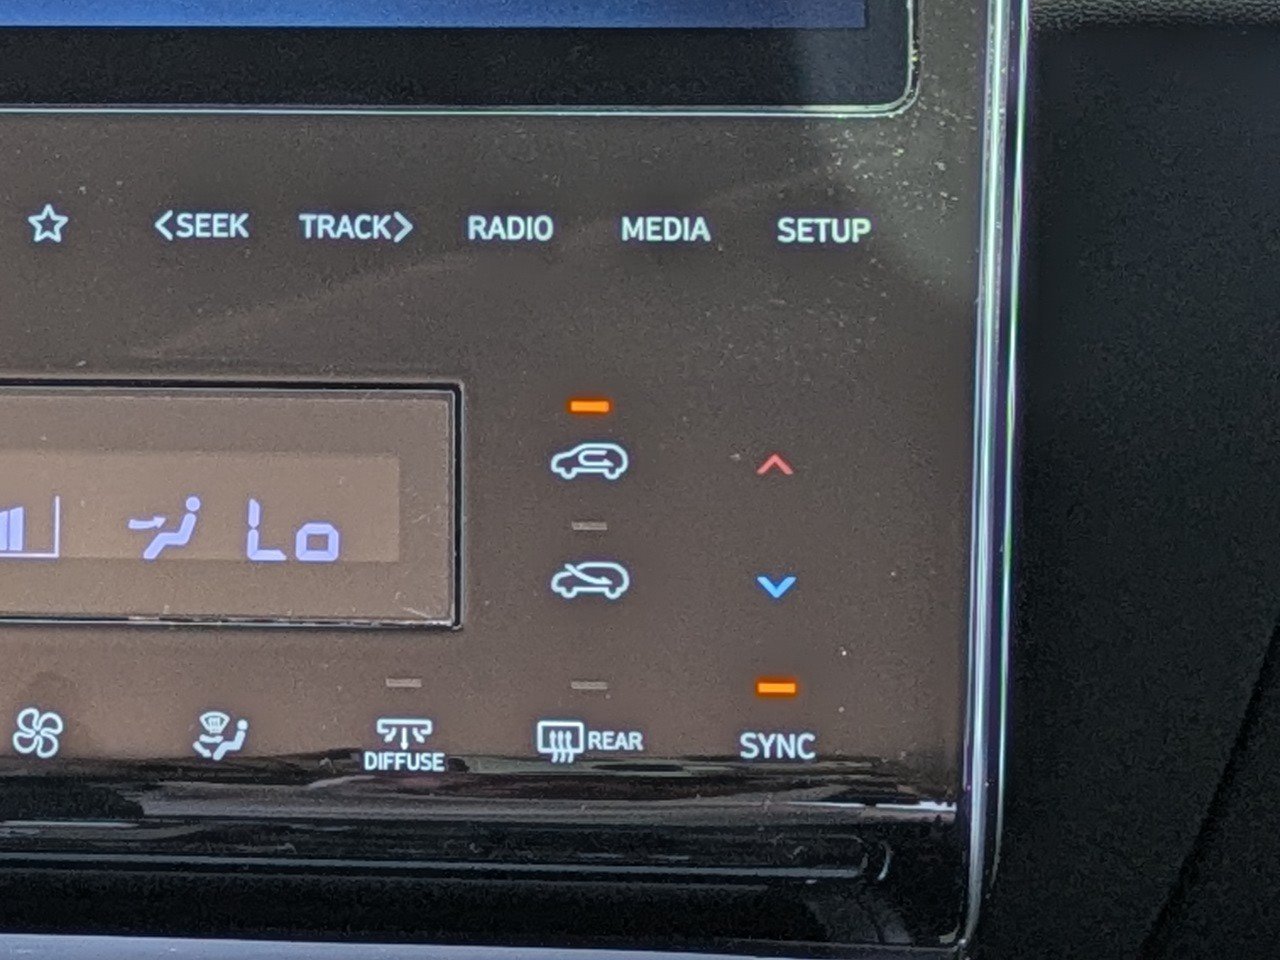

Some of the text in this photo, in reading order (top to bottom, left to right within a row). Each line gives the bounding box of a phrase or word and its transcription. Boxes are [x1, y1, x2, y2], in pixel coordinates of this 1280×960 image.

[468, 215, 553, 240] RADIO
[622, 216, 711, 242] MEDIA
[777, 217, 871, 243] SETUP
[247, 499, 340, 562] Lo
[588, 731, 643, 751] REAR
[739, 733, 816, 760] SYNC
[364, 752, 445, 772] DIFFUSE
